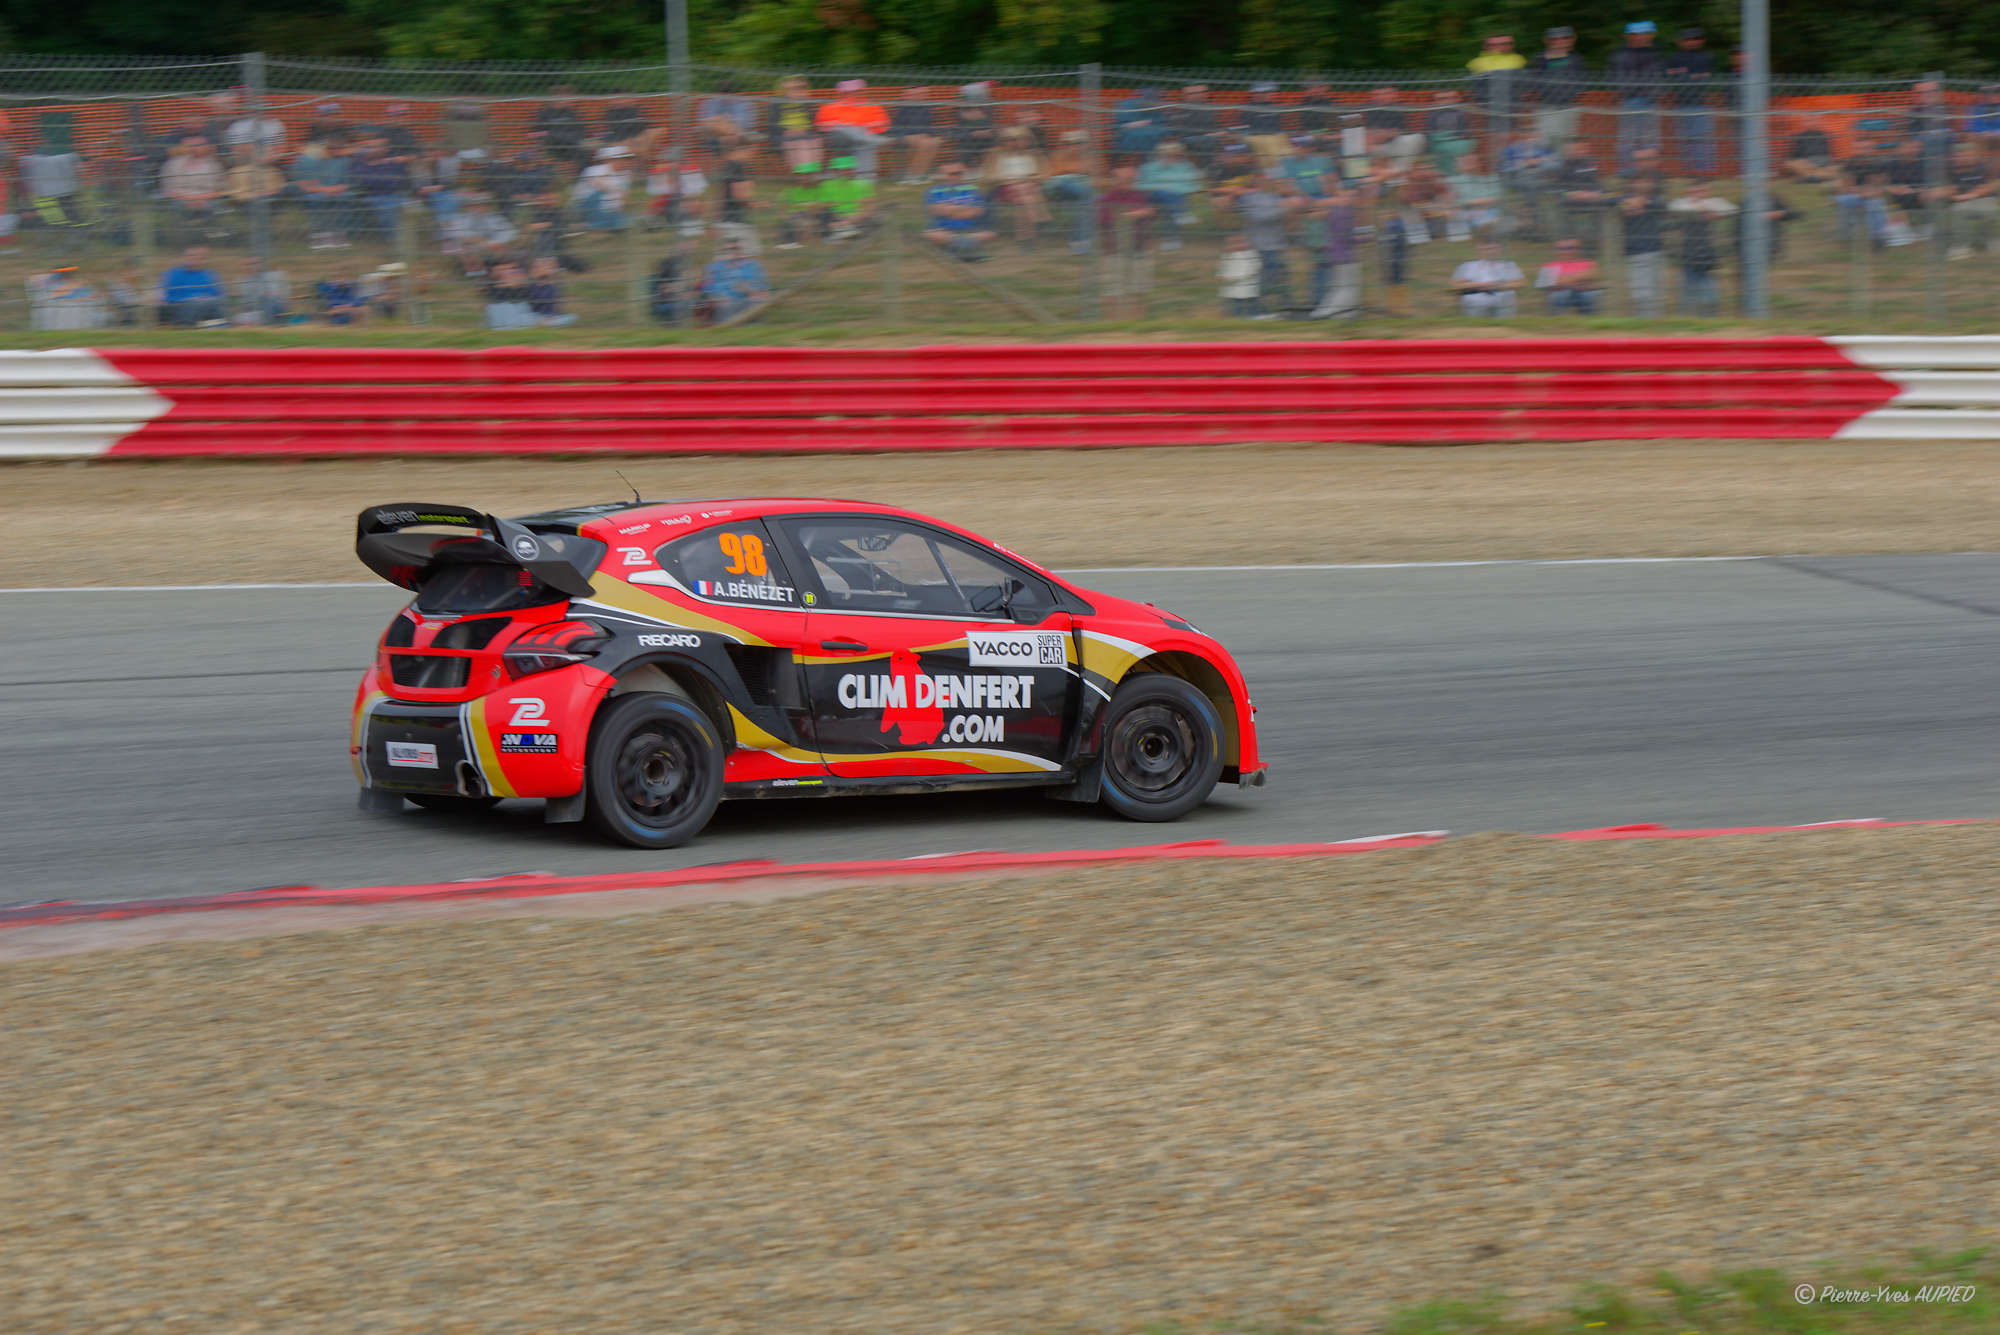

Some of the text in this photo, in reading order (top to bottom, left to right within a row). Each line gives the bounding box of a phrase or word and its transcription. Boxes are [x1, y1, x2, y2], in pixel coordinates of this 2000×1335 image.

[719, 532, 767, 576] 98
[637, 634, 701, 648] RECARO
[973, 641, 1033, 656] YACCO
[1037, 634, 1062, 646] SUPER
[1040, 647, 1063, 664] CAR
[837, 673, 1035, 709] CLIM DENFERT
[941, 714, 1005, 743] .COM
